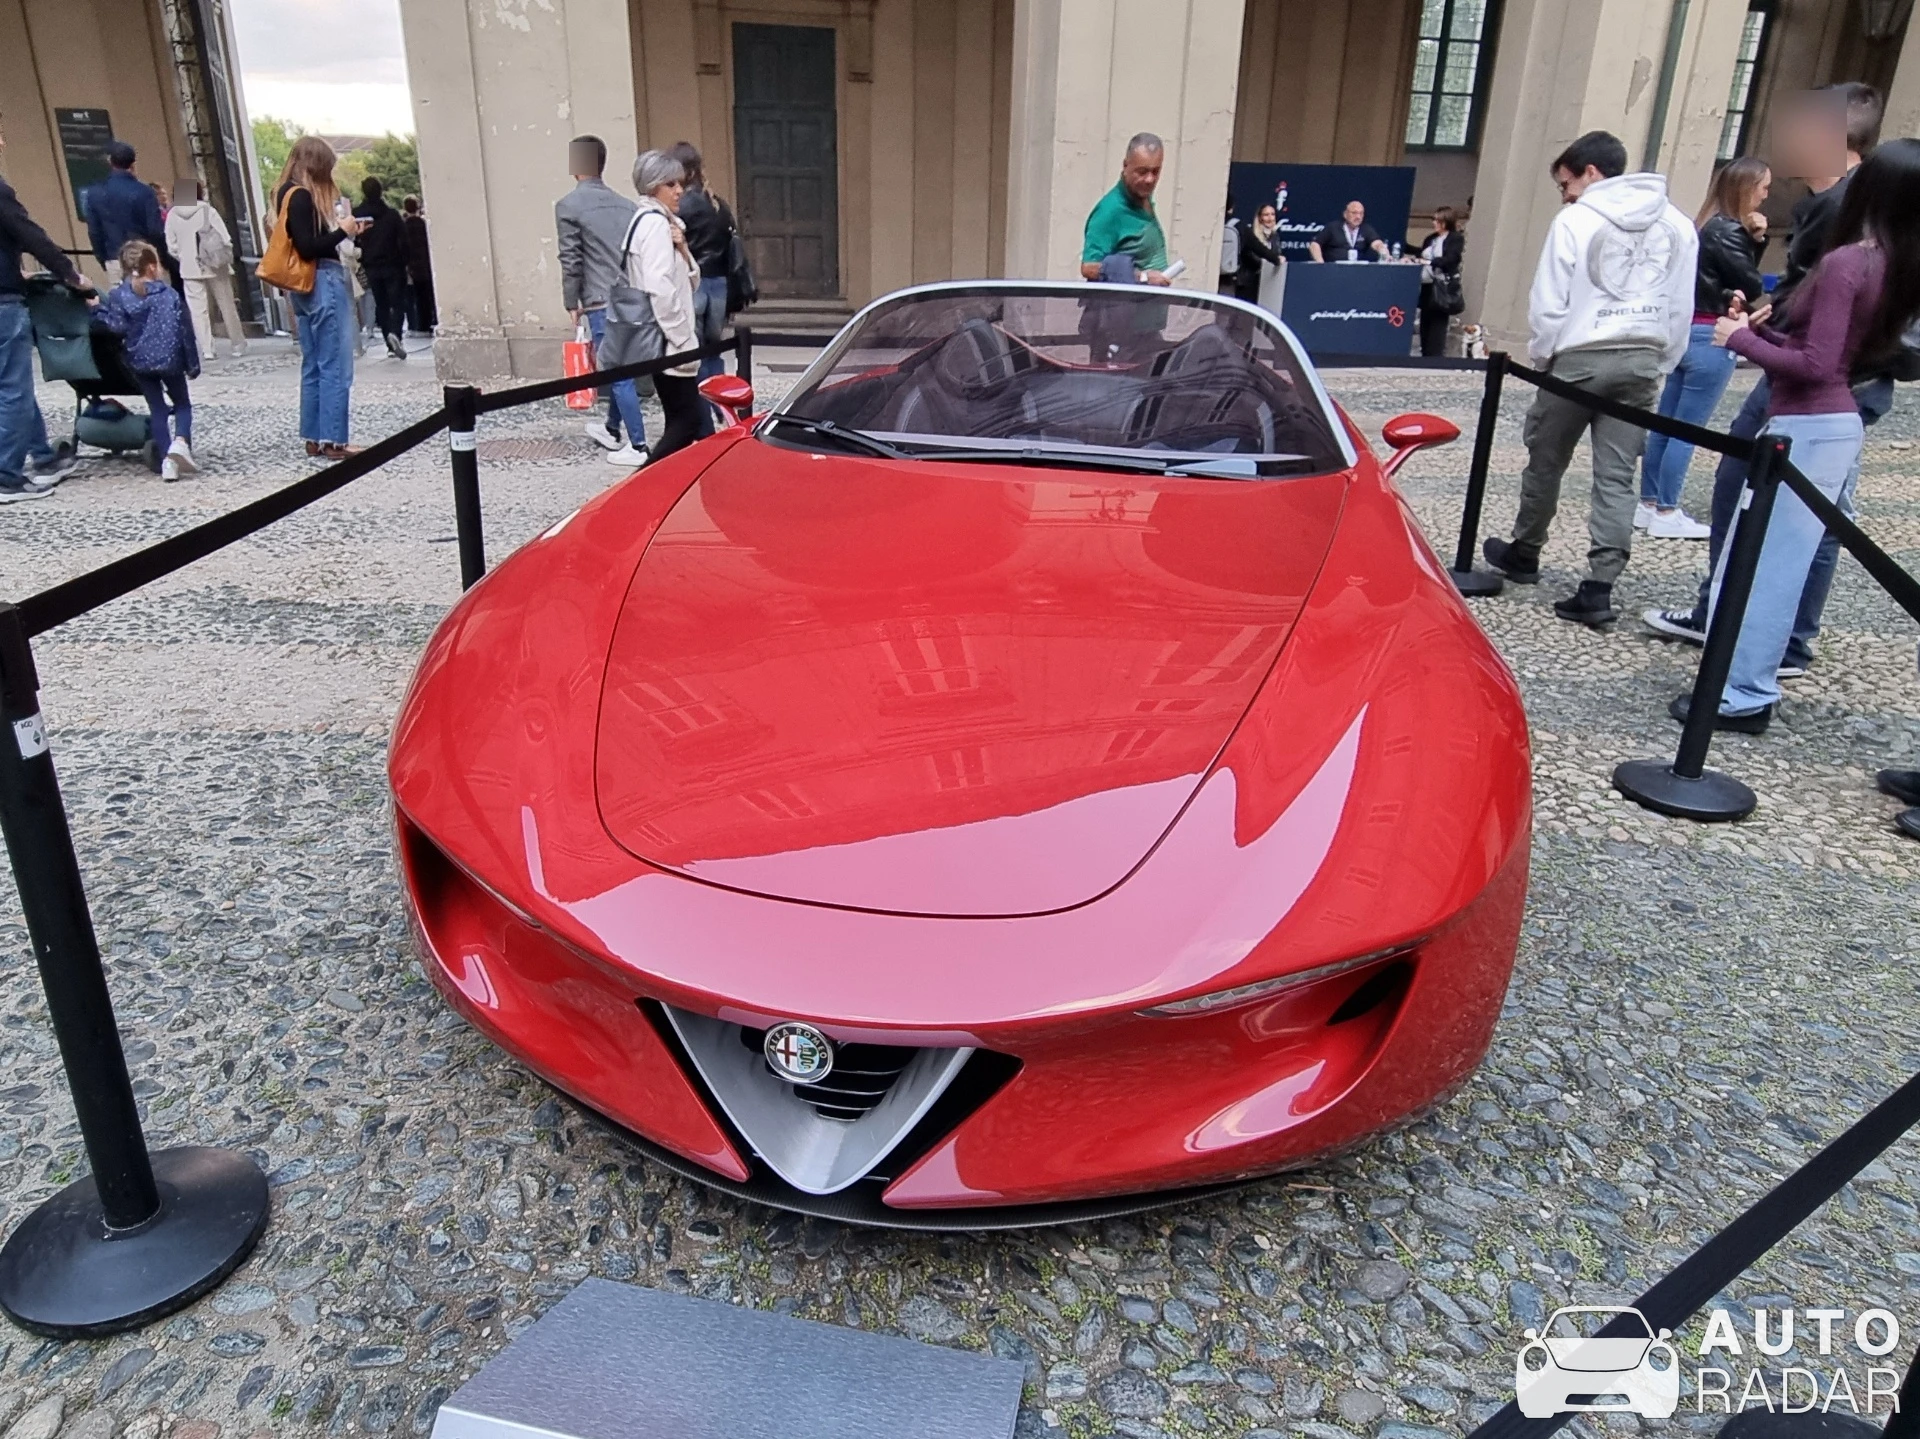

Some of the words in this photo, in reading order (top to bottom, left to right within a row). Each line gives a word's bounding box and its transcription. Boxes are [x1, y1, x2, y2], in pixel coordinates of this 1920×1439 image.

[1309, 308, 1388, 321] pininfarina
[1597, 305, 1662, 318] SHELBY
[769, 1028, 789, 1052] ALFA
[796, 1028, 828, 1059] ROMEO
